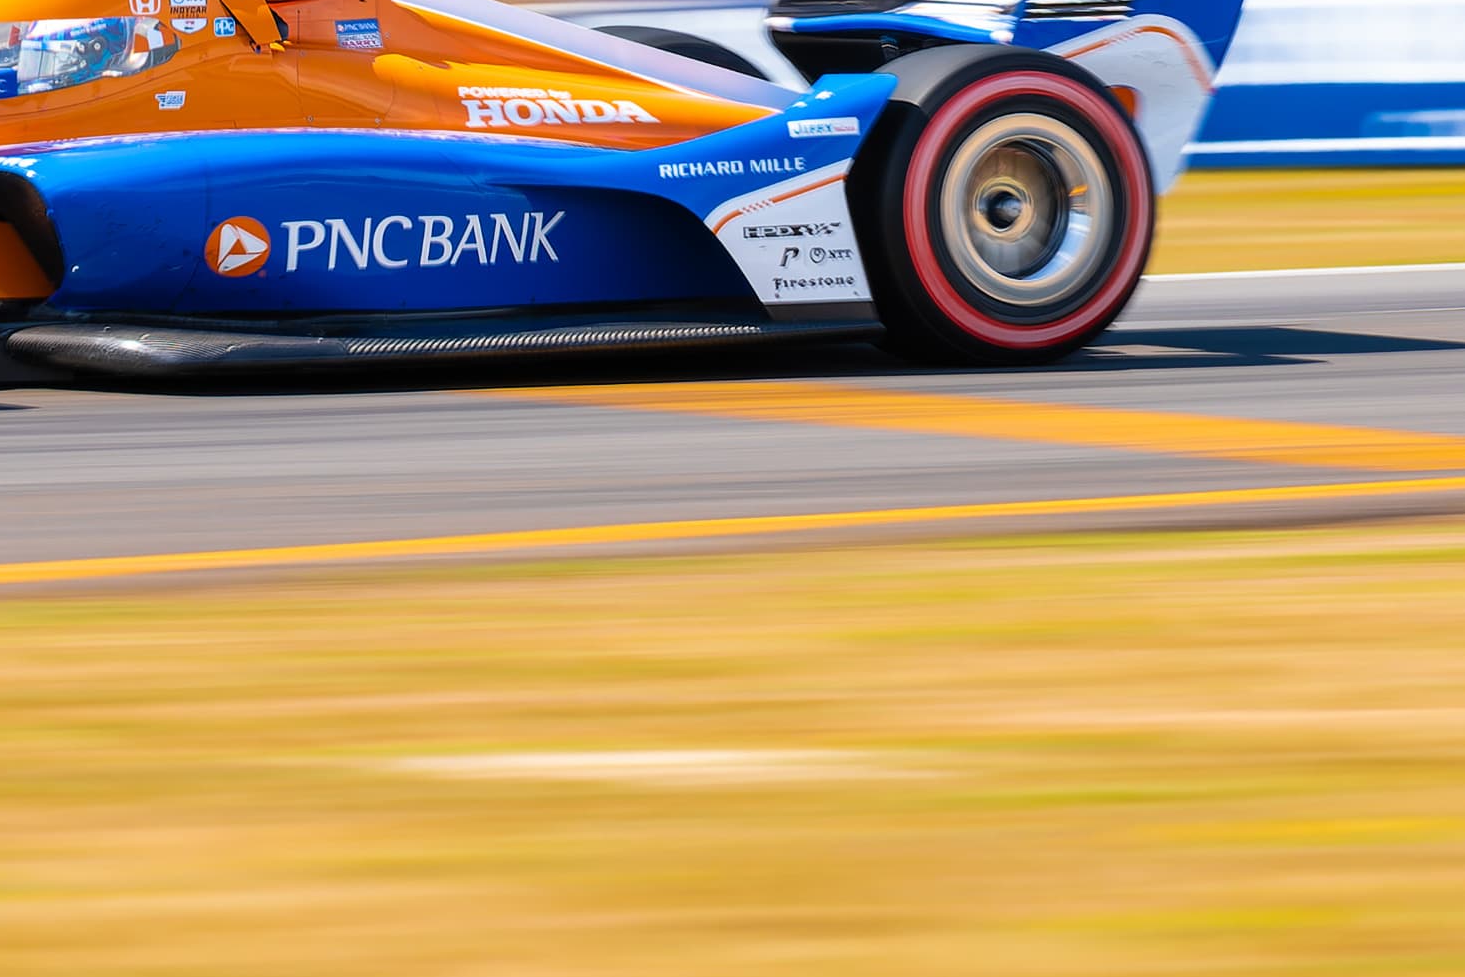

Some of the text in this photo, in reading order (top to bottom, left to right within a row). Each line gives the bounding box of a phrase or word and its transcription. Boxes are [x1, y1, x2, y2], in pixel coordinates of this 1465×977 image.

[170, 5, 207, 14] INDYCAR
[458, 86, 547, 99] POWERED
[461, 99, 661, 128] HONDA
[659, 157, 807, 179] RICHARD MILLE
[743, 226, 794, 239] HPD
[280, 211, 565, 272] PNC BANK
[828, 249, 853, 260] NTT
[773, 276, 855, 291] Firestone
